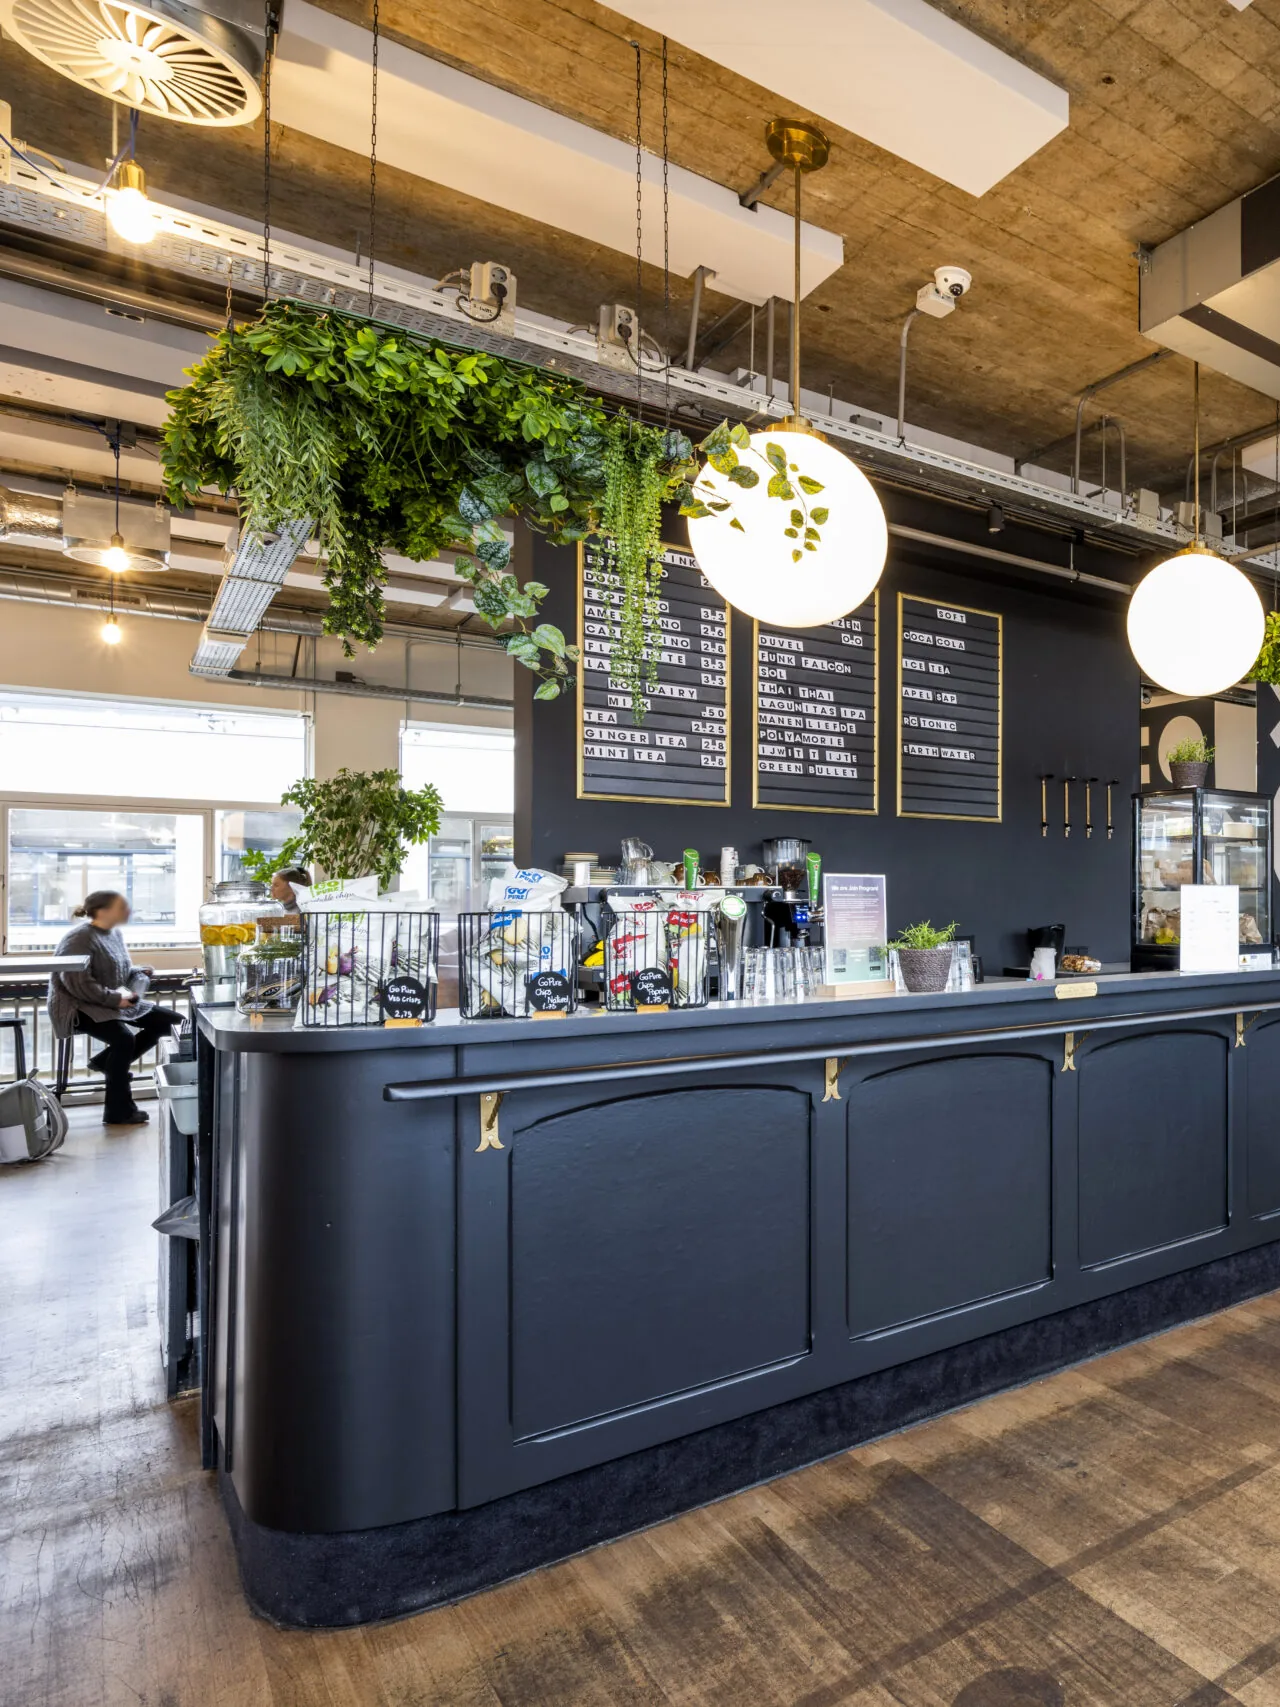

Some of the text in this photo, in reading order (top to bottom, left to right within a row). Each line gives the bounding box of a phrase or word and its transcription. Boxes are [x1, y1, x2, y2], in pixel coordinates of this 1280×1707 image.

[587, 608, 724, 636] AMERCANO 2.6
[703, 610, 724, 621] 3.3
[938, 610, 965, 622] SOFT
[586, 625, 724, 653] CAPCINO 2.8
[760, 636, 801, 650] DUVEL
[904, 632, 964, 649] COCA COLA
[703, 660, 724, 669] 3.3
[761, 652, 851, 673] FUNK FALCON
[905, 660, 950, 674] ICE TEA
[703, 675, 724, 686] 3.3
[760, 667, 785, 679] SOL
[648, 684, 695, 698] DAIRY
[761, 683, 831, 700] THAI THAI
[904, 689, 956, 702] APEL SAP
[609, 697, 724, 718] MIK .50
[761, 699, 865, 719] LAGUNITAS IPA
[586, 711, 724, 734] TEA 2.25
[760, 715, 854, 733] MANEN LIEFDE
[922, 719, 956, 730] TONIC
[586, 729, 724, 750] GINGER TEA 2.8
[760, 731, 842, 746] POLYAMORIE
[586, 747, 724, 766] MINT TEA 2.8
[904, 745, 976, 760] EARTH WATER
[760, 762, 856, 777] GREEN BULLET
